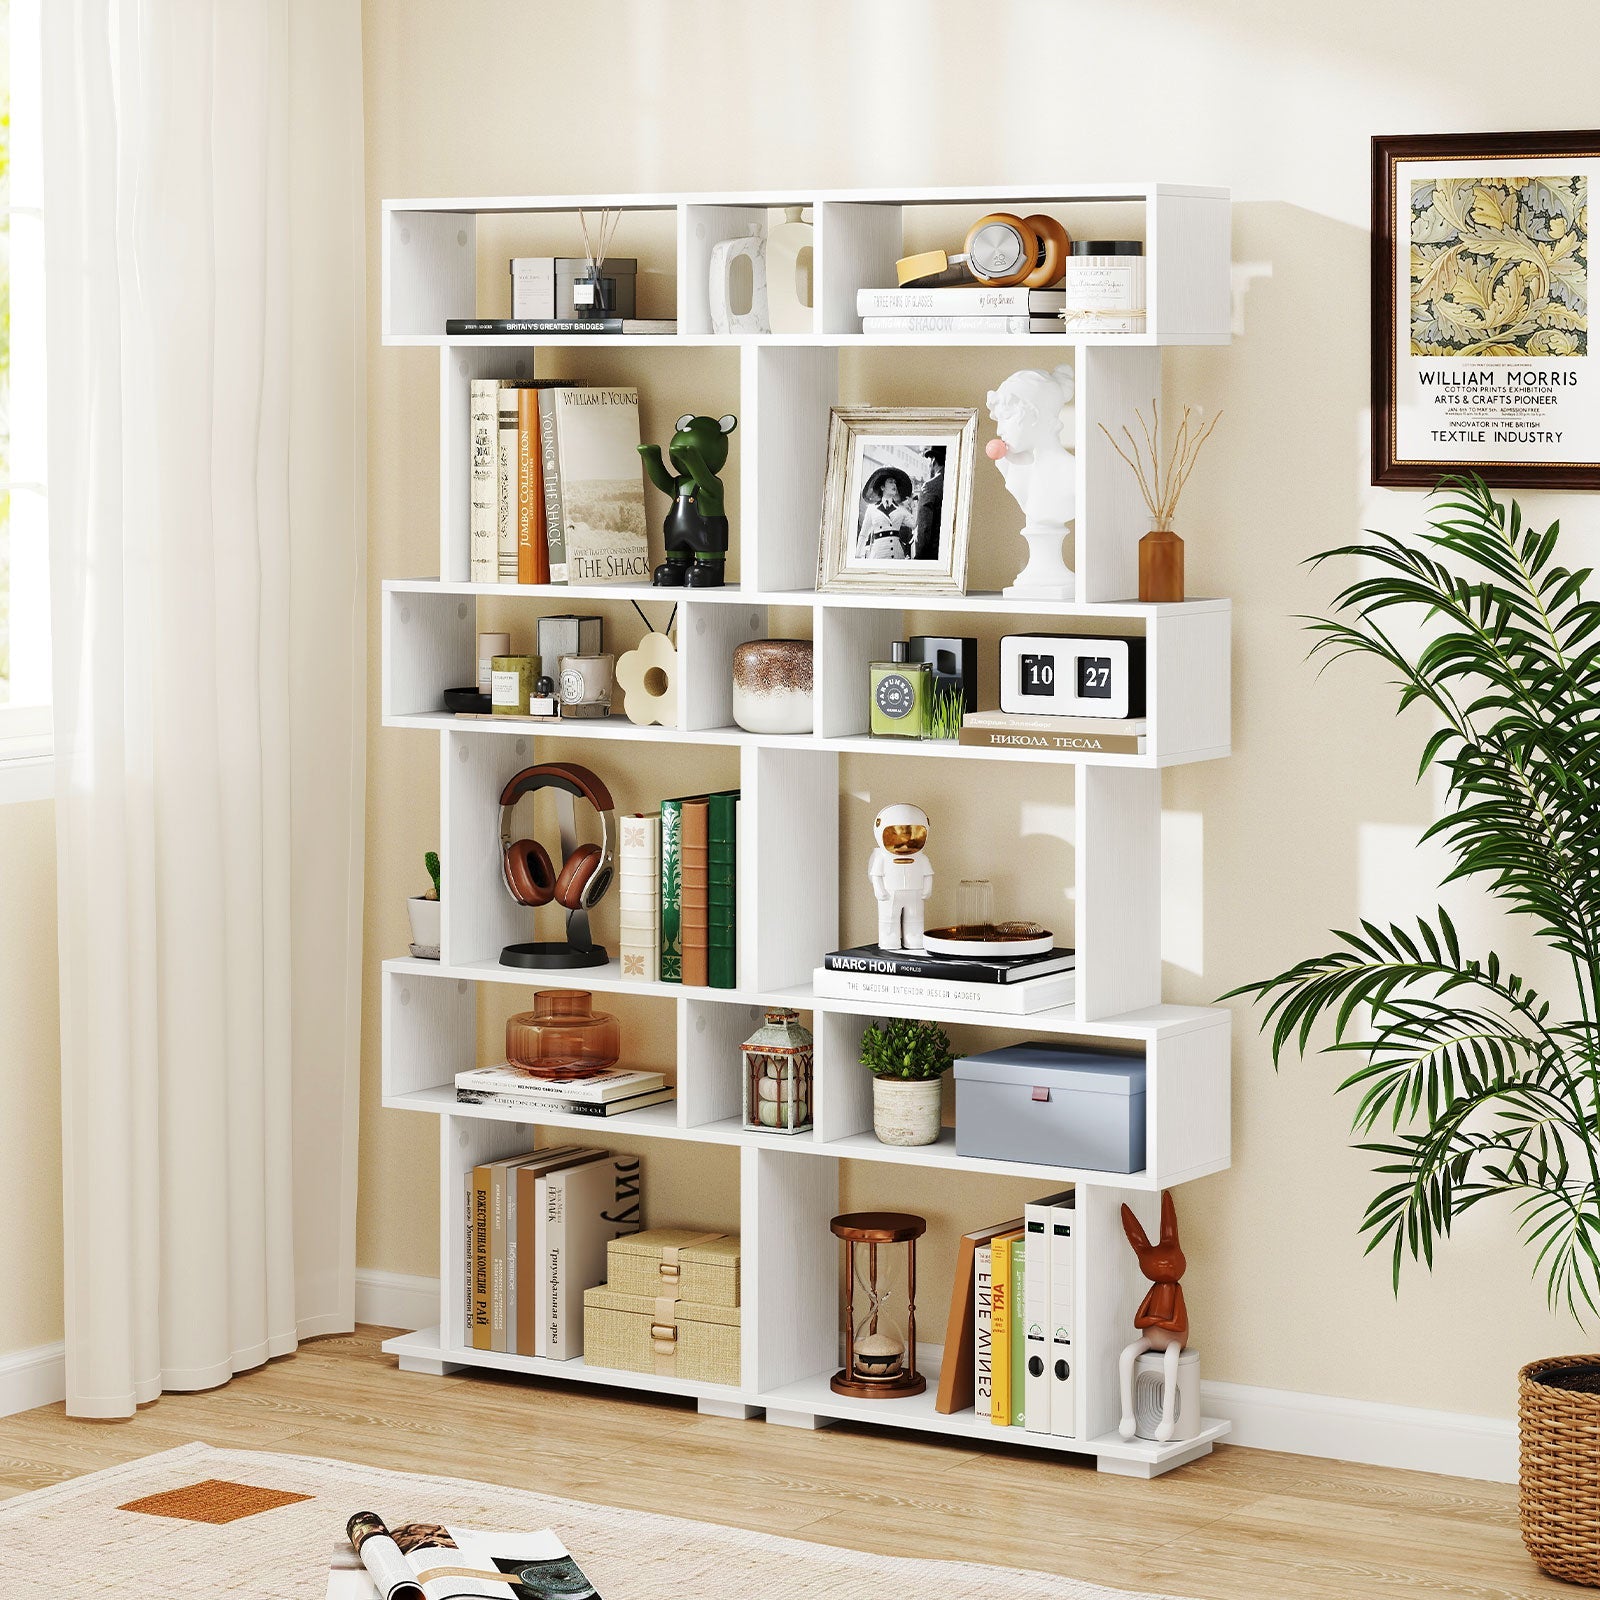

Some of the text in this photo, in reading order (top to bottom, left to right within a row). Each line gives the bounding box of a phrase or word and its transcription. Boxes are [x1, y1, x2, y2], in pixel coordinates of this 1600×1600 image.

[506, 323, 604, 331] BRITAIN'S GREATEST BRIDGES
[908, 318, 953, 331] SHADOW
[1418, 371, 1578, 386] WILLIAM MORRIS
[564, 392, 598, 405] WILLIAM
[608, 392, 638, 405] YOUNG
[1434, 395, 1558, 405] ARTS & CRAFTS PIONEER
[1430, 431, 1563, 443] TEXTILE INDUSTRY
[542, 412, 562, 547] YOUNG THE SHACK
[520, 430, 531, 547] JUMBO COLLECTION
[574, 555, 650, 579] THE SHACK
[1030, 665, 1053, 685] 10
[1085, 667, 1110, 687] 27
[889, 692, 900, 701] 48
[990, 734, 1103, 750] НИКОЛА ТЕСЛА
[832, 957, 867, 971] MARC
[869, 961, 897, 974] HOM
[848, 982, 981, 1001] THE SWEDISH INTERIOR DESIGN GADGETS
[494, 1098, 559, 1109] MOCKINGBIRD
[466, 1224, 474, 1260] Уличный
[476, 1190, 489, 1326] БОЖЕСТВЕННАЯ КОМЕДИЯ РАЙ
[466, 1276, 472, 1286] по
[550, 1247, 560, 1344] Триумфальная арка
[466, 1313, 474, 1329] Боб
